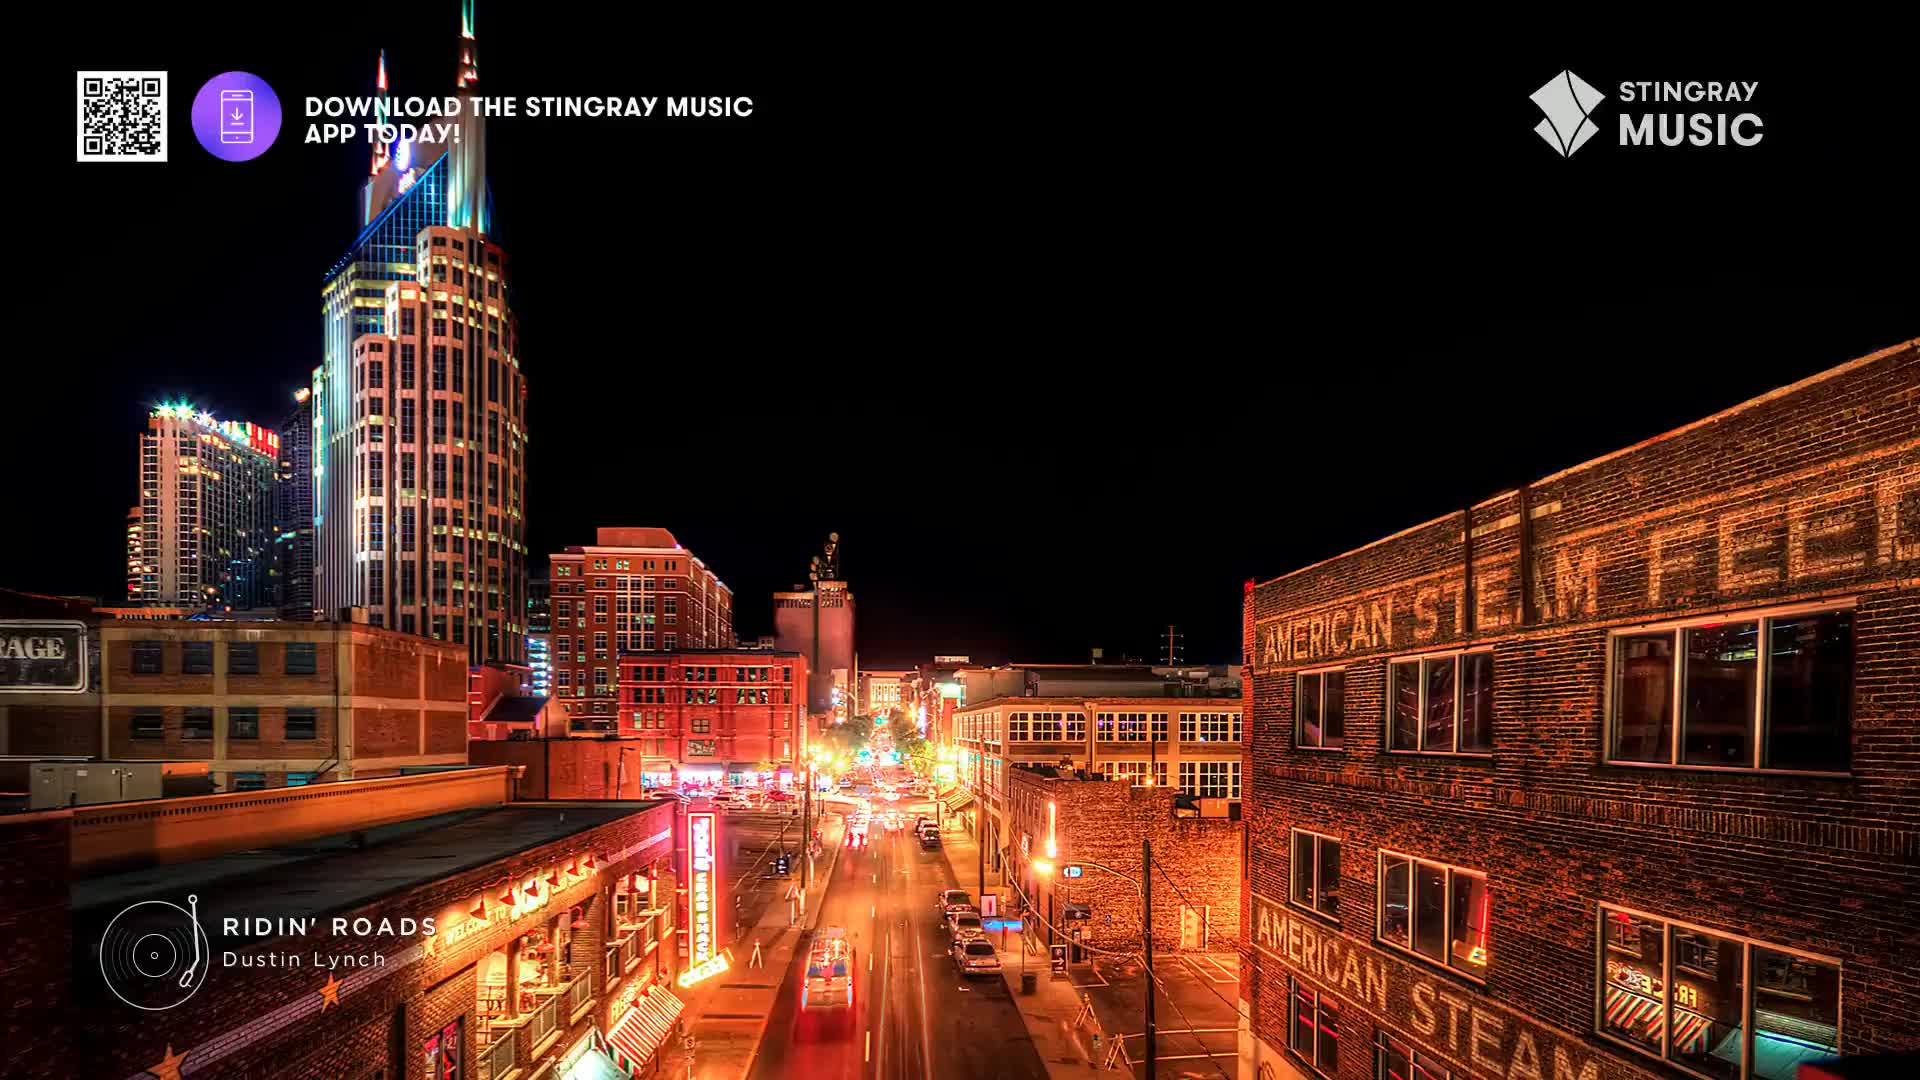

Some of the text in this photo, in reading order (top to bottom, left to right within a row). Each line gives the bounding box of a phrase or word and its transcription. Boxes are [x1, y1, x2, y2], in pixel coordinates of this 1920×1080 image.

[0, 636, 66, 660] AGE
[1263, 593, 1393, 664] AMERICAN
[695, 913, 710, 962] SHACK
[1257, 905, 1388, 1012] AMERICAN
